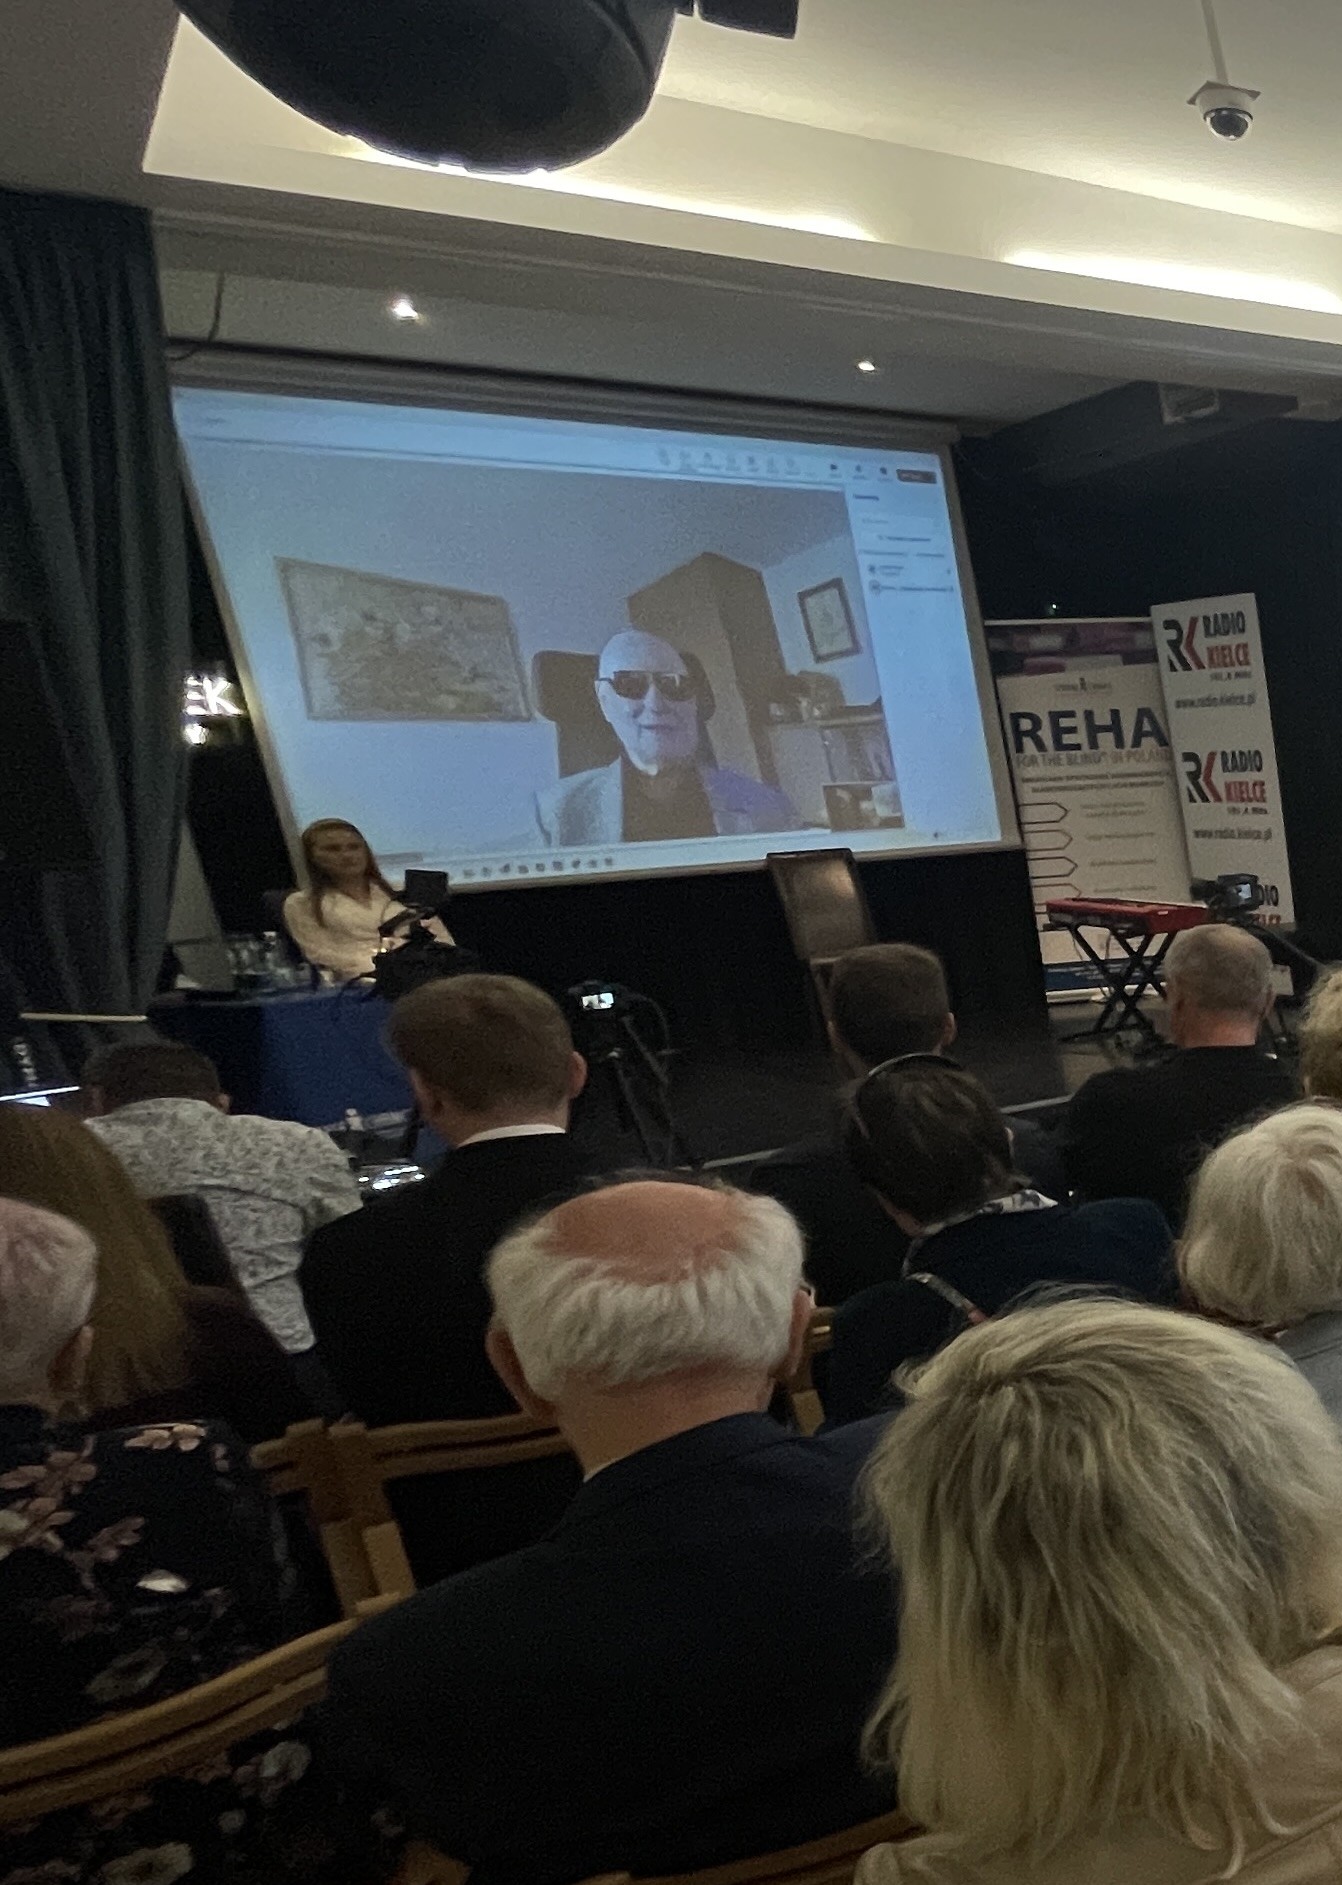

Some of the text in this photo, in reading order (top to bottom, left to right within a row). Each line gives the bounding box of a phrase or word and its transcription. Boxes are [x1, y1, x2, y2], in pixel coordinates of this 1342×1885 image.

[1203, 610, 1245, 638] RADIO
[1206, 642, 1251, 669] KIELCE
[1009, 706, 1170, 754] REHA
[1221, 750, 1263, 773] RADIO
[1224, 780, 1267, 803] KIELCE
[1256, 884, 1280, 907] DIO
